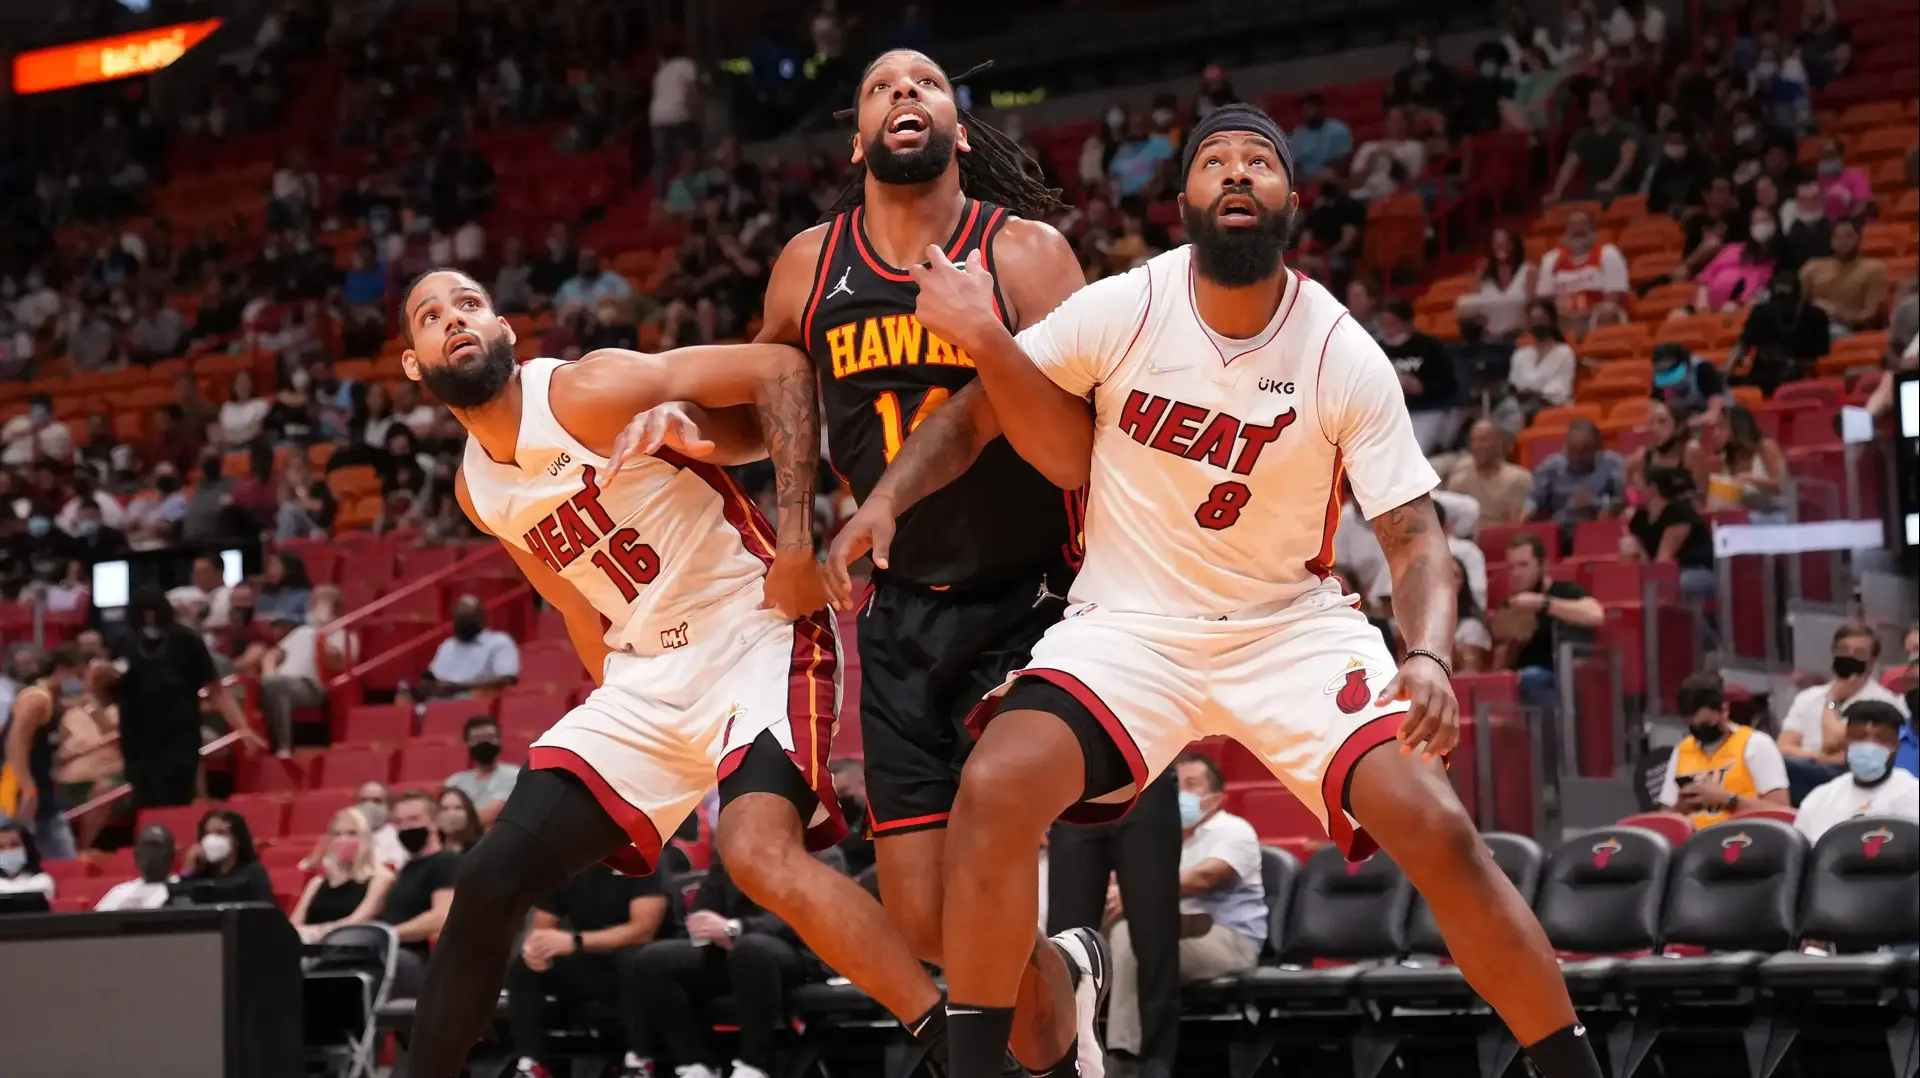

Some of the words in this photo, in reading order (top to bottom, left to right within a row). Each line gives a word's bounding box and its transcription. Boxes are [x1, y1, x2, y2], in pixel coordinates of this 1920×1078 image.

[825, 313, 977, 380] HAWK
[1118, 388, 1297, 476] HEAT
[522, 463, 617, 574] HEAT
[1194, 480, 1252, 531] 8
[590, 527, 661, 604] 16
